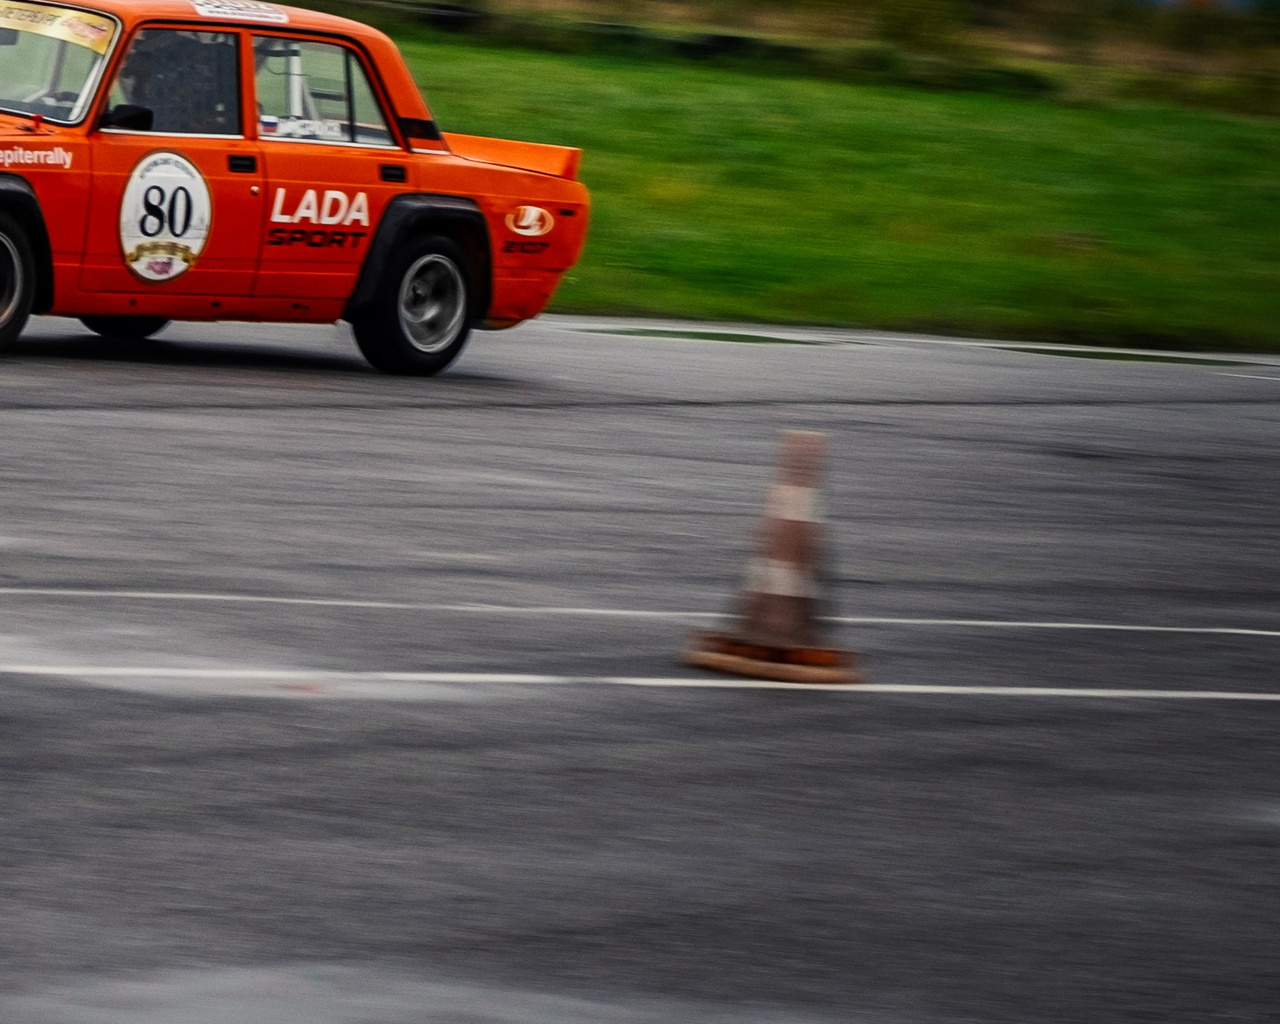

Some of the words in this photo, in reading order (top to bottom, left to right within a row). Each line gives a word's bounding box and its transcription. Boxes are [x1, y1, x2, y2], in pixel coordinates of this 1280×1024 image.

[139, 185, 193, 238] 80
[270, 187, 370, 226] LADA
[267, 228, 367, 249] SPORT
